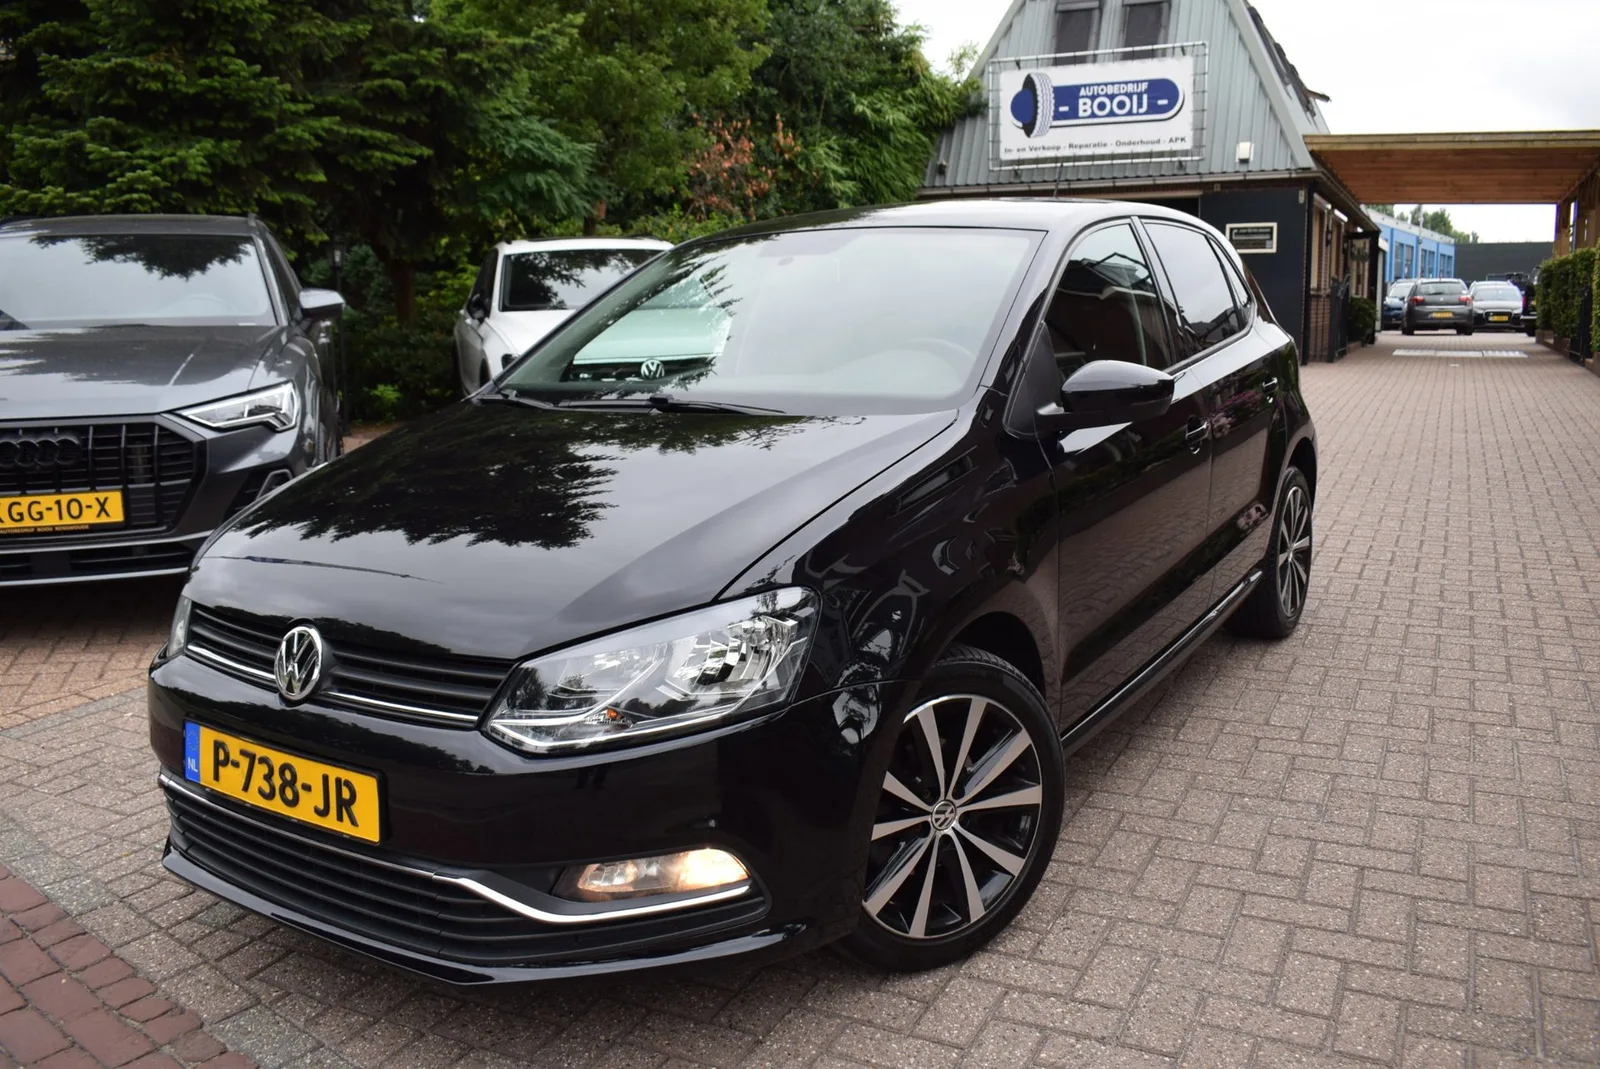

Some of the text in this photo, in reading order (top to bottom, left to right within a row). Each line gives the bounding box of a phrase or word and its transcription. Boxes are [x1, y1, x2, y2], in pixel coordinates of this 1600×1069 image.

[1080, 82, 1149, 96] AUTOBEDRIJF
[1079, 94, 1148, 117] BOOIJ
[1068, 141, 1108, 150] Reparatie
[1115, 137, 1161, 147] Onderhoud
[1168, 136, 1187, 144] APK
[187, 756, 199, 773] NL
[213, 739, 360, 828] P-738-JR
